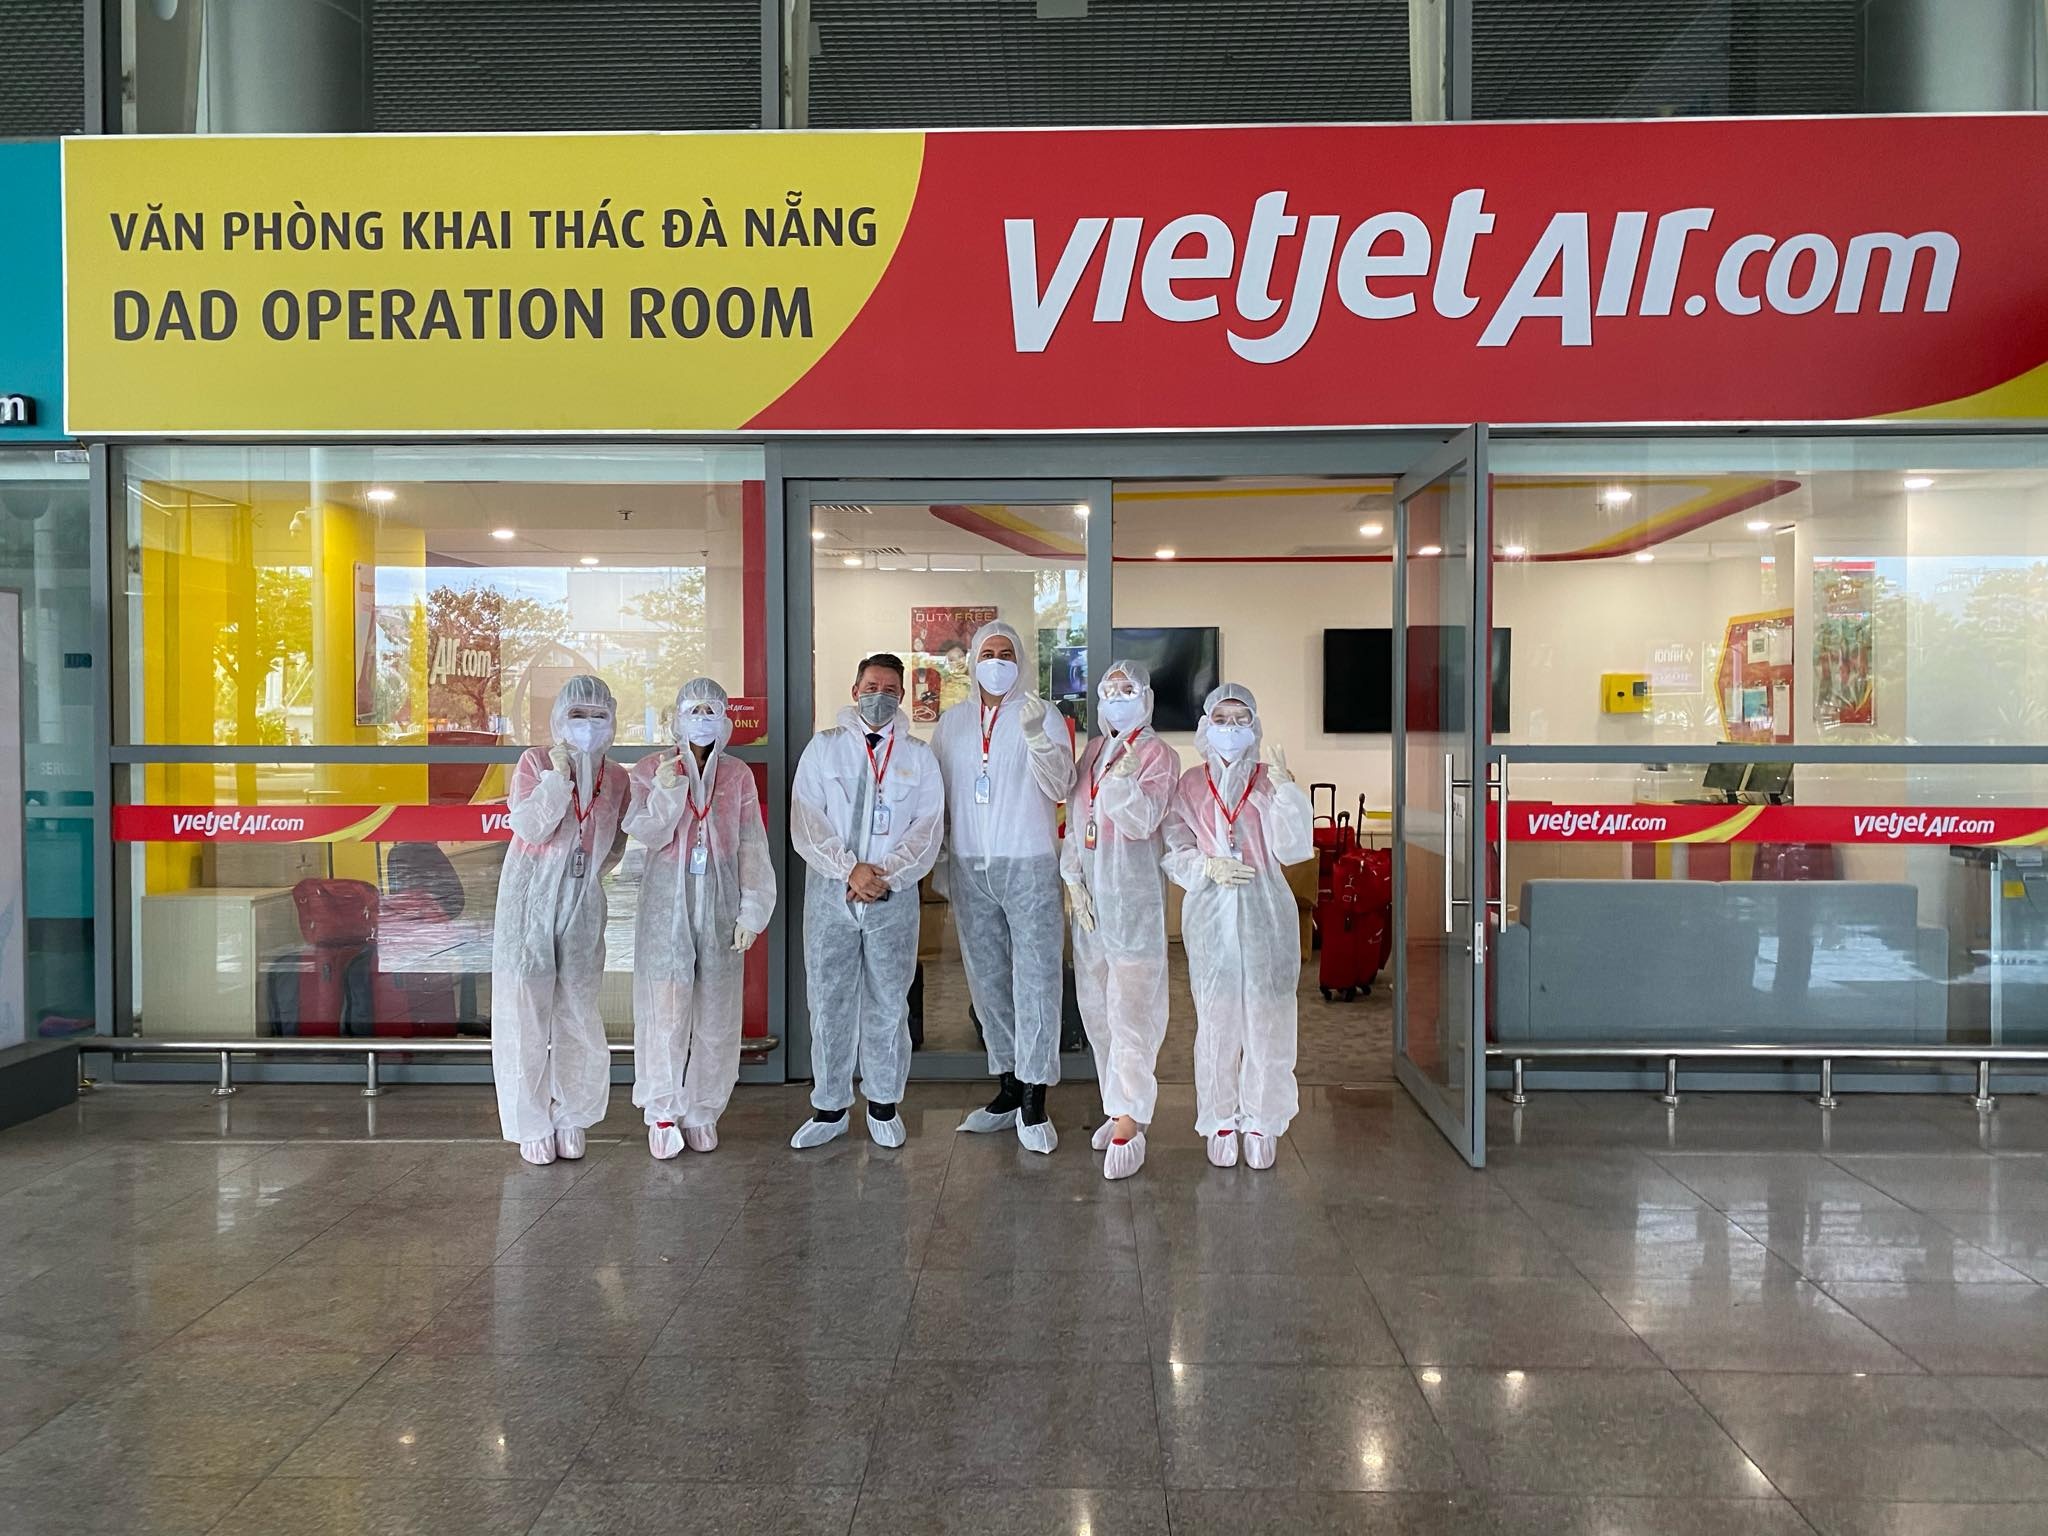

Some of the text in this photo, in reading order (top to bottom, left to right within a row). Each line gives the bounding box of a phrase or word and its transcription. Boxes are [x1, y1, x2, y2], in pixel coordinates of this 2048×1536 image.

[110, 190, 877, 252] VĂN PHÒNG KHAI THÁC ĐÀ NẴNG
[113, 285, 814, 342] DAD OPERATION ROOM
[916, 613, 952, 622] DUTY
[429, 637, 492, 685] Air.com
[735, 719, 760, 728] ONLY
